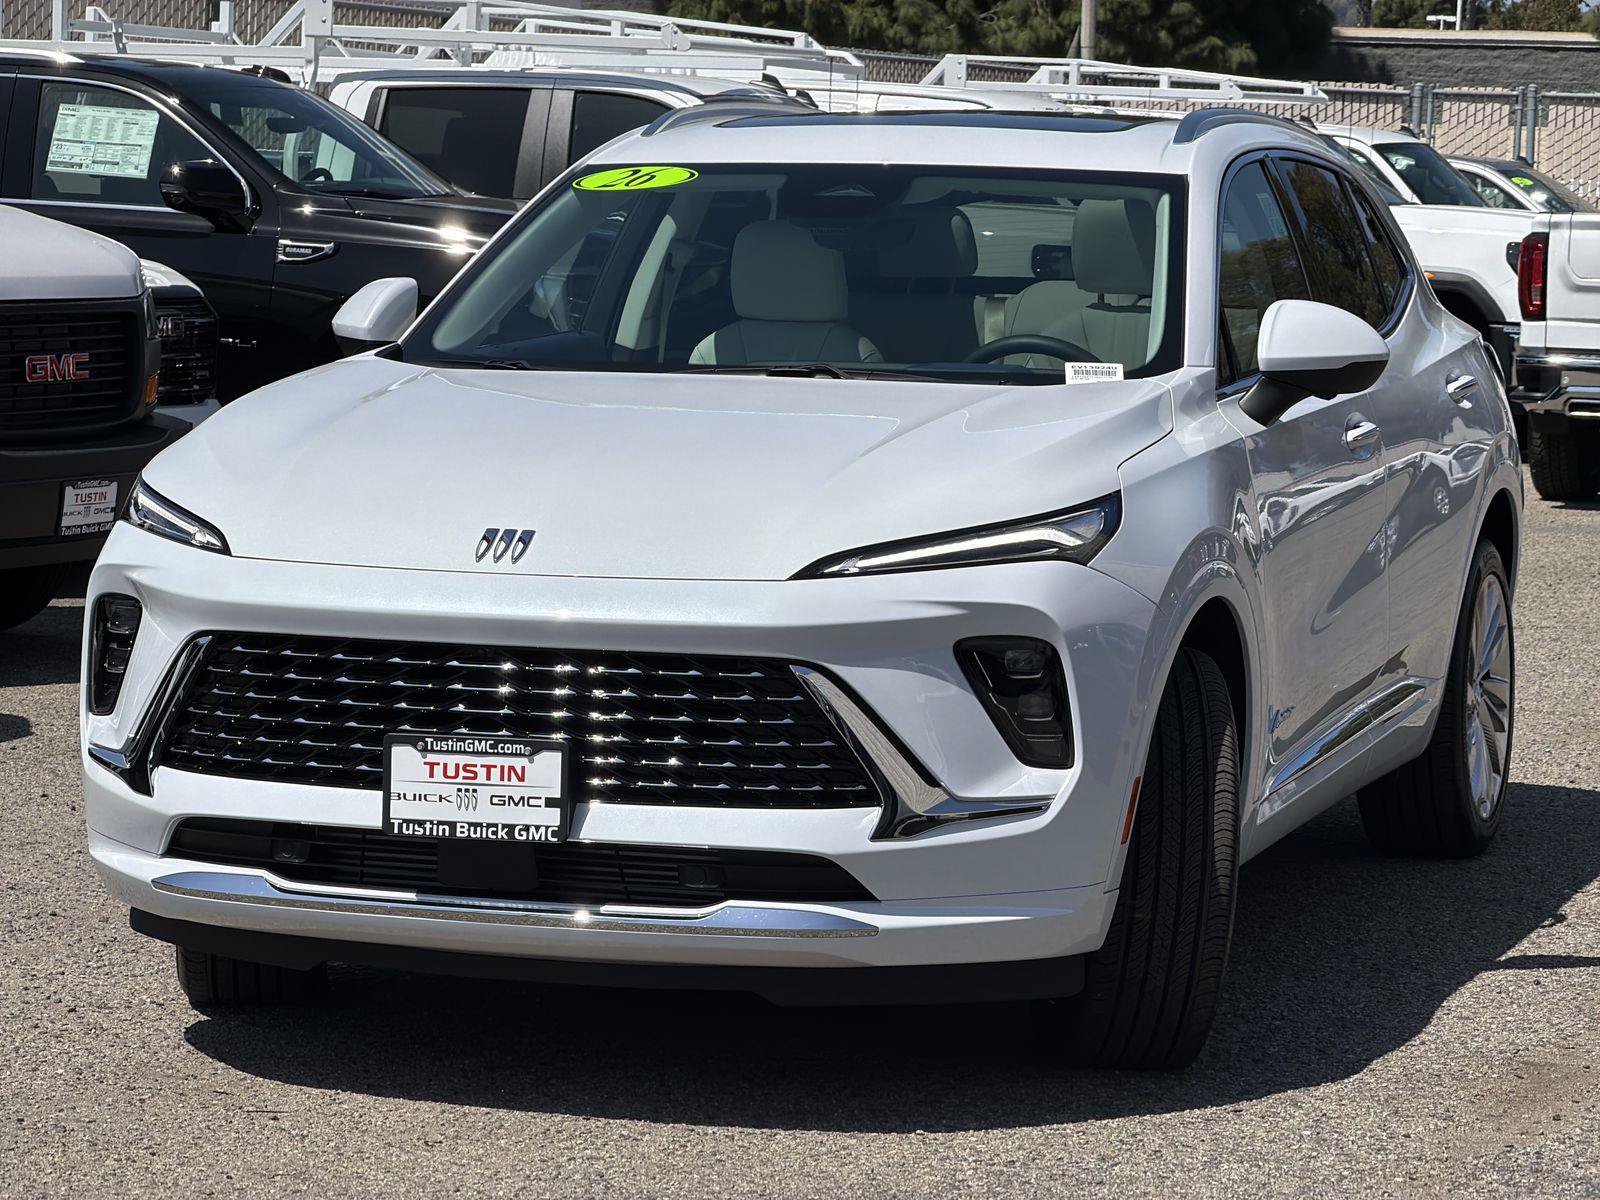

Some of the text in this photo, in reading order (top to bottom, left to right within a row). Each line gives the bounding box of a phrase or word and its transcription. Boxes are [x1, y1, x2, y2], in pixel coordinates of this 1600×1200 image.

[594, 168, 673, 188] 26
[25, 353, 90, 382] GMC
[74, 491, 107, 503] TUSTIN
[93, 507, 111, 515] GMC
[61, 526, 80, 536] Tustin
[81, 523, 99, 534] Buick
[425, 738, 524, 755] TustinGMC.com
[423, 761, 526, 783] TUSTIN
[489, 794, 542, 808] GMC
[390, 818, 559, 842] Tustin Buick GMC
